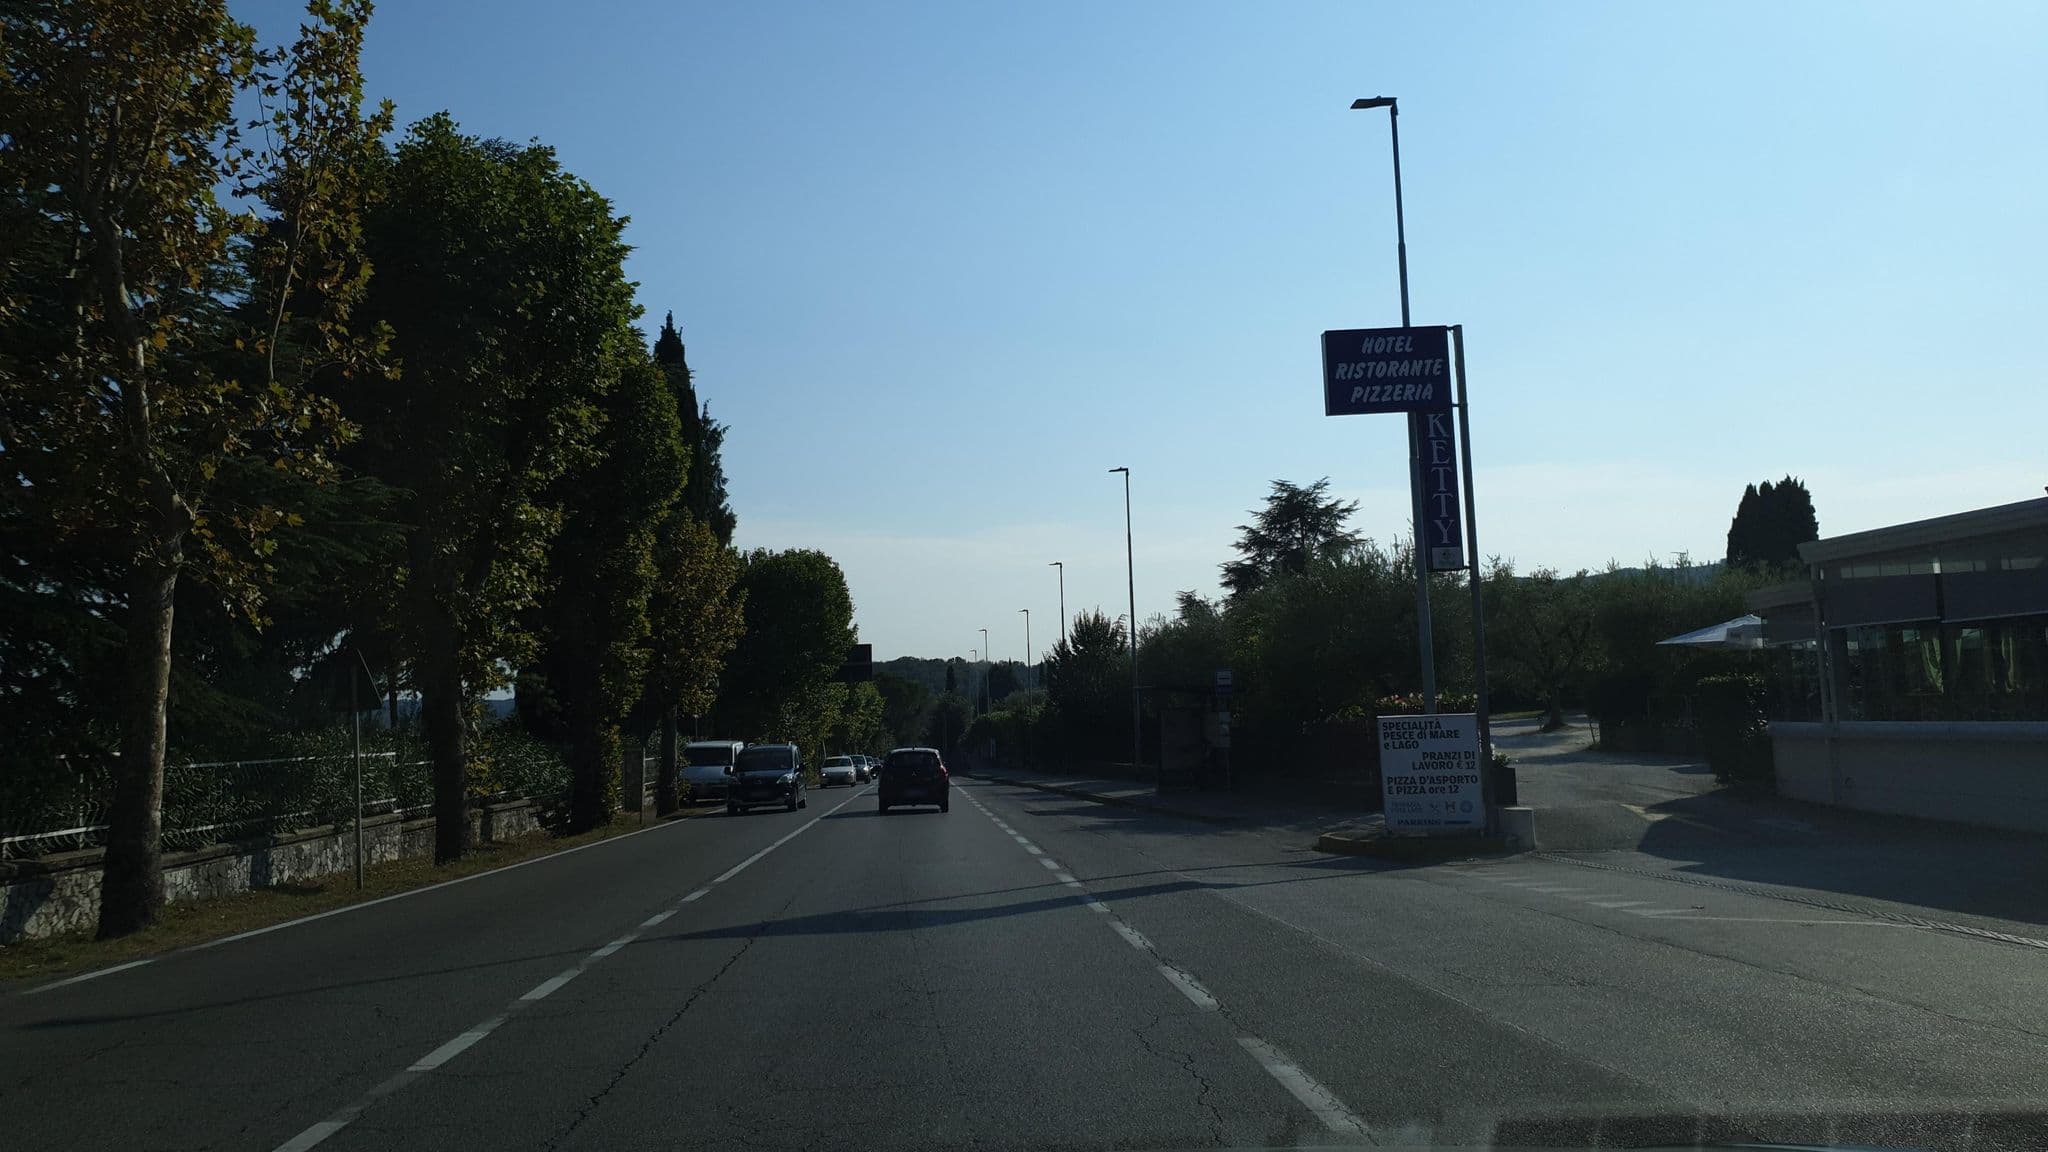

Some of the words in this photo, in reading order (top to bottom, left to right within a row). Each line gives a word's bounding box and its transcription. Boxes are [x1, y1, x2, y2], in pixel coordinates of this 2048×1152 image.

[1361, 335, 1414, 354] HOTEL
[1335, 358, 1443, 380] RISTORANTE
[1350, 383, 1433, 403] PIZZERIA
[1426, 413, 1455, 544] KETTY
[1382, 718, 1442, 731] SPECIALITÀ
[1383, 731, 1414, 740] PESCE
[1417, 730, 1427, 739] di
[1429, 729, 1460, 739] MARE
[1383, 742, 1390, 750] e
[1392, 740, 1419, 750] LAGO
[1422, 751, 1461, 760] PRANZI
[1464, 750, 1475, 760] DI
[1412, 760, 1454, 770] LAVORO
[1387, 776, 1417, 786] PIZZA
[1419, 775, 1478, 785] D'ASPORTO
[1388, 786, 1393, 795] E
[1396, 785, 1426, 795] PIZZA
[1428, 786, 1446, 794] ore
[1449, 785, 1459, 794] 12
